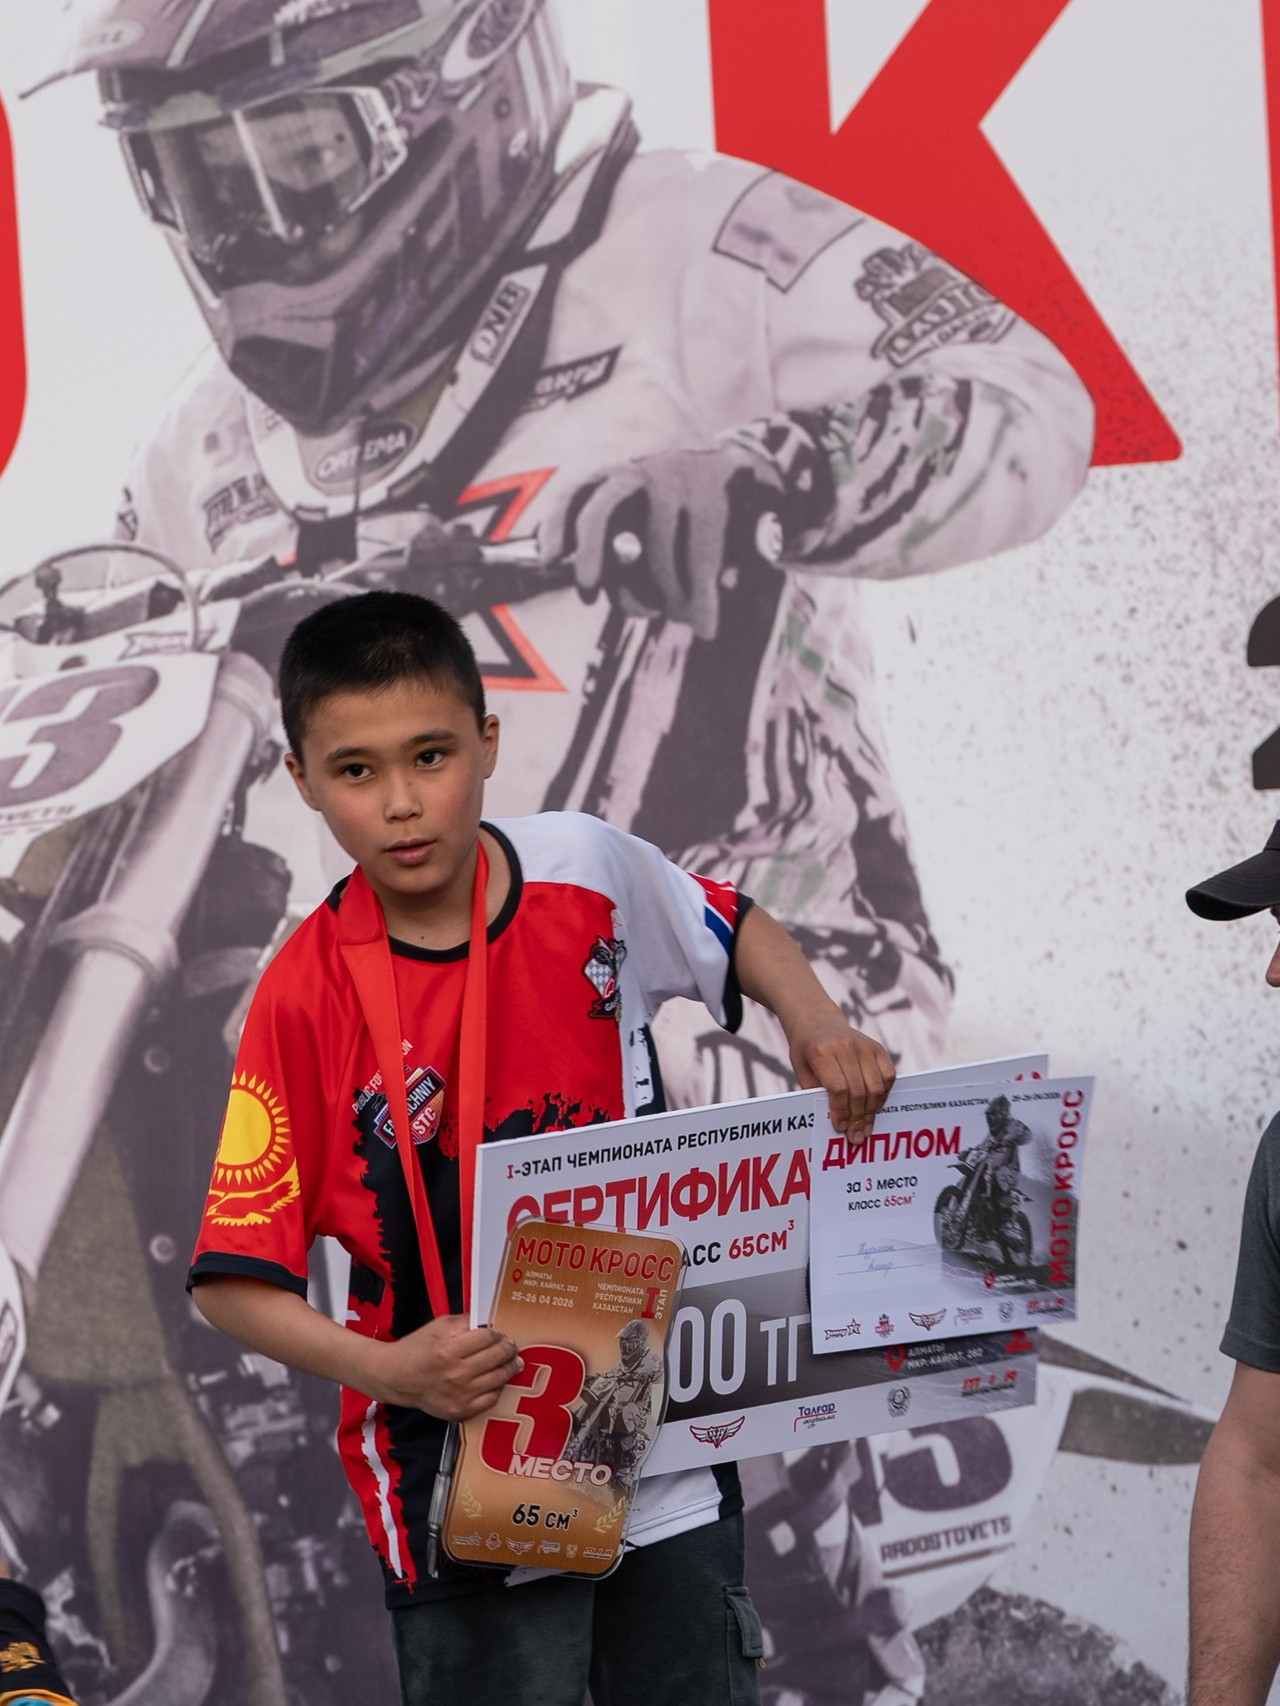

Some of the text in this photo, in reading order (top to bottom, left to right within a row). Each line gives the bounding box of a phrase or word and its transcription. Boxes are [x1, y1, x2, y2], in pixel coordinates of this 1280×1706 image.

[707, 0, 1280, 468] К
[411, 1106, 437, 1135] STC
[506, 1155, 563, 1180] I-ЭТАП
[566, 1136, 673, 1168] ЧЕМПИОНАТА
[676, 1117, 783, 1151] РЕСПУБЛИКИ
[822, 1125, 962, 1172] ДИПЛОМ
[506, 1146, 813, 1236] СЕРТИФИКА
[846, 1174, 919, 1194] за 3 место
[1048, 1089, 1085, 1284] МОТО КРОСС
[848, 1198, 882, 1212] класс
[514, 1236, 676, 1283] МОТО КРОСС
[594, 1292, 643, 1306] РЕСПУБЛИКИ
[597, 1282, 645, 1296] ЧЕМПИОНАТА
[654, 1288, 669, 1321] ЭТАП
[592, 1302, 634, 1315] КАЗАХСТАН
[478, 1343, 587, 1477] 3
[507, 1453, 614, 1487] МЕСТО
[511, 1502, 542, 1528] 65
